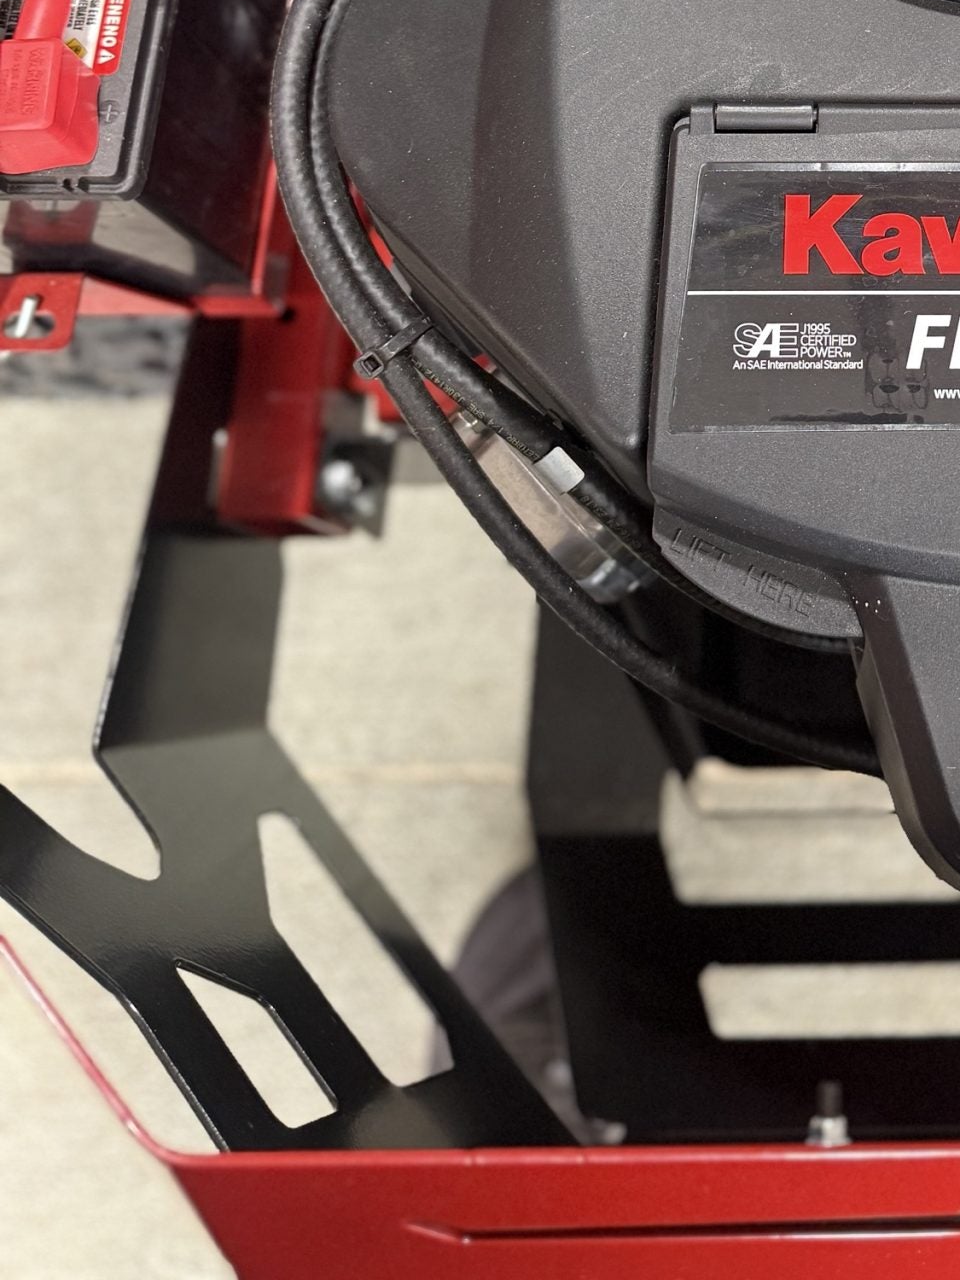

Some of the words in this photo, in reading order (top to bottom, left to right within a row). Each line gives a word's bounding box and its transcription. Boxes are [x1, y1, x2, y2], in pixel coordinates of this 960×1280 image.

[800, 323, 831, 335] J1995
[733, 322, 800, 359] SAE
[800, 334, 858, 347] CERTIFIED
[733, 359, 747, 371] An
[747, 359, 767, 370] SAE
[767, 359, 823, 370] International
[823, 359, 864, 370] Standard
[671, 527, 732, 572] LIFT
[743, 563, 818, 618] HERE
